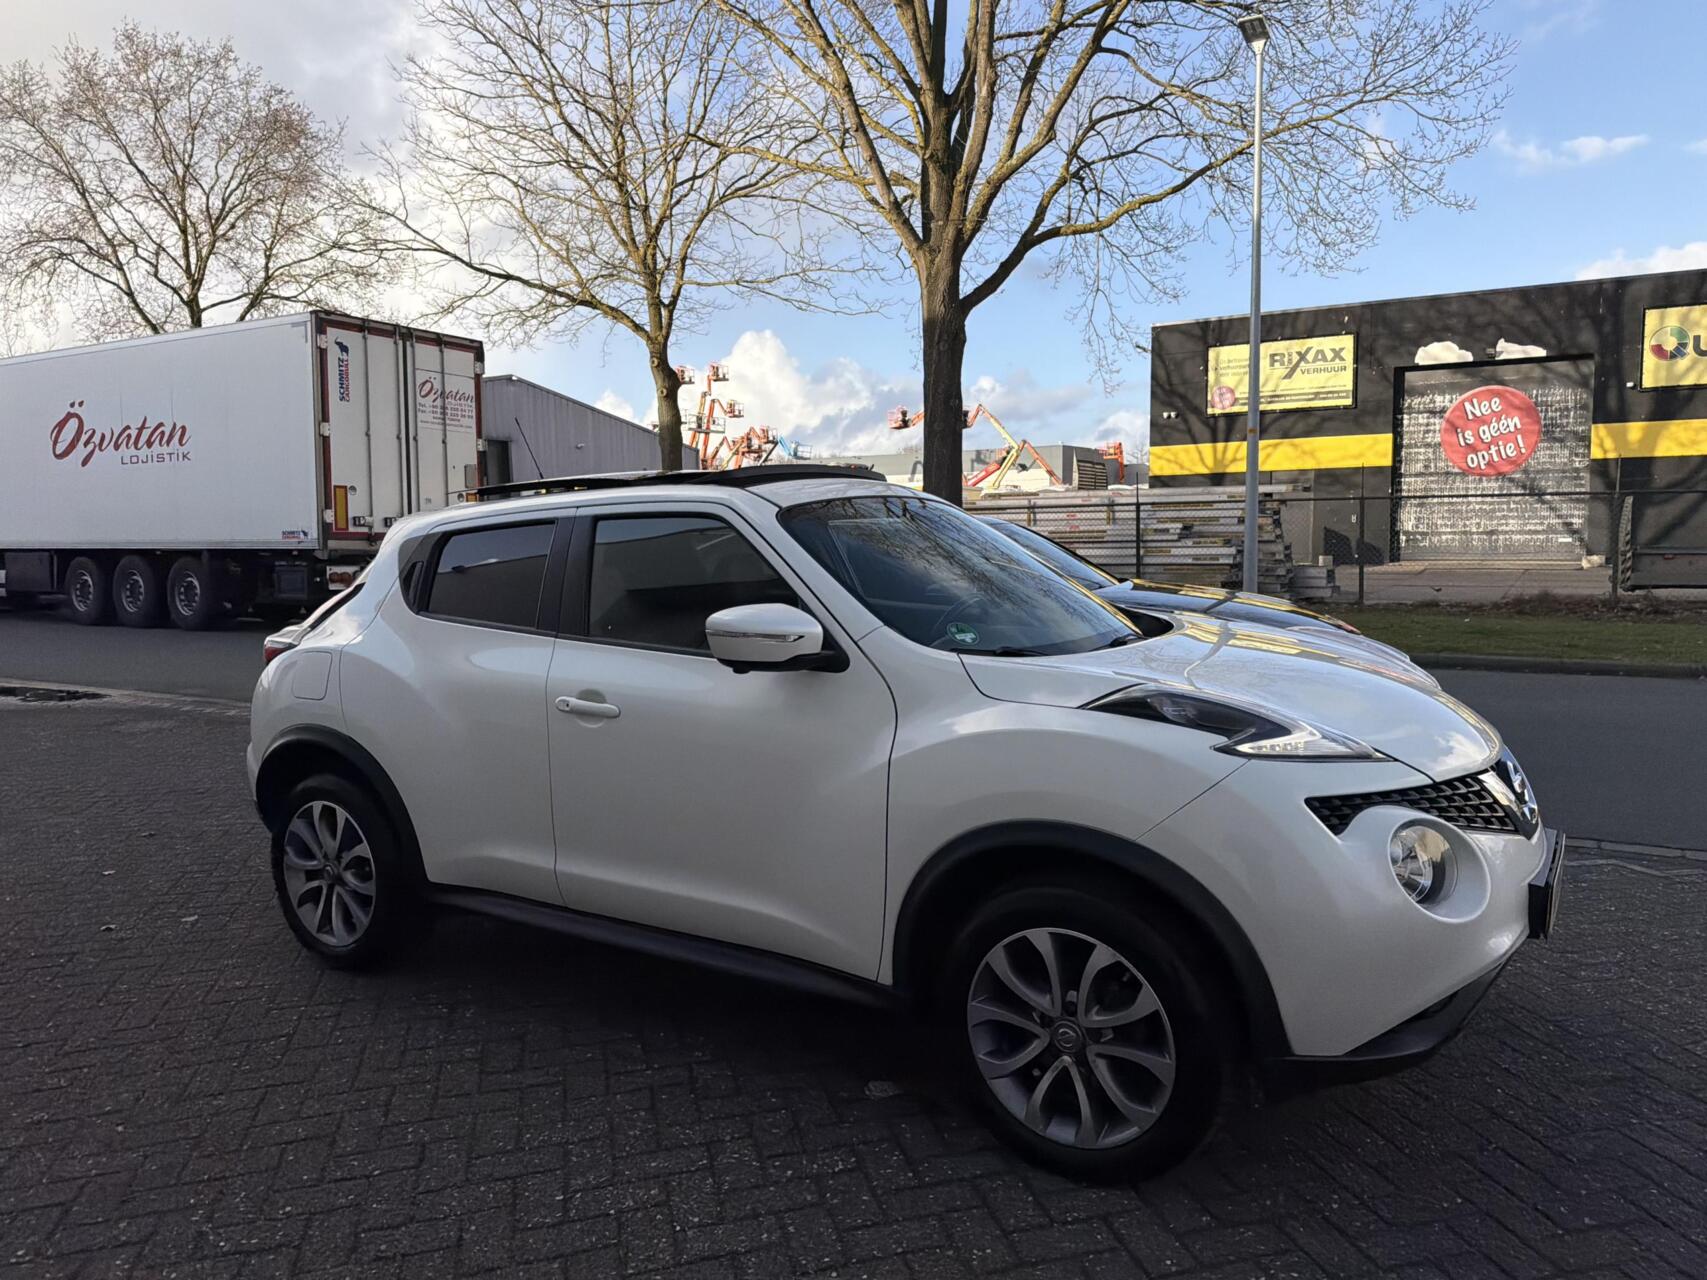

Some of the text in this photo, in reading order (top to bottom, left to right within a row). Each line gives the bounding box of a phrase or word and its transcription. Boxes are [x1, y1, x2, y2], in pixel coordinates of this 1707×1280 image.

[1300, 365, 1347, 375] VERHUUR
[1464, 397, 1502, 420] Nee
[50, 400, 191, 467] Özvatan
[1457, 414, 1521, 446] is géén
[1467, 434, 1526, 469] optie!
